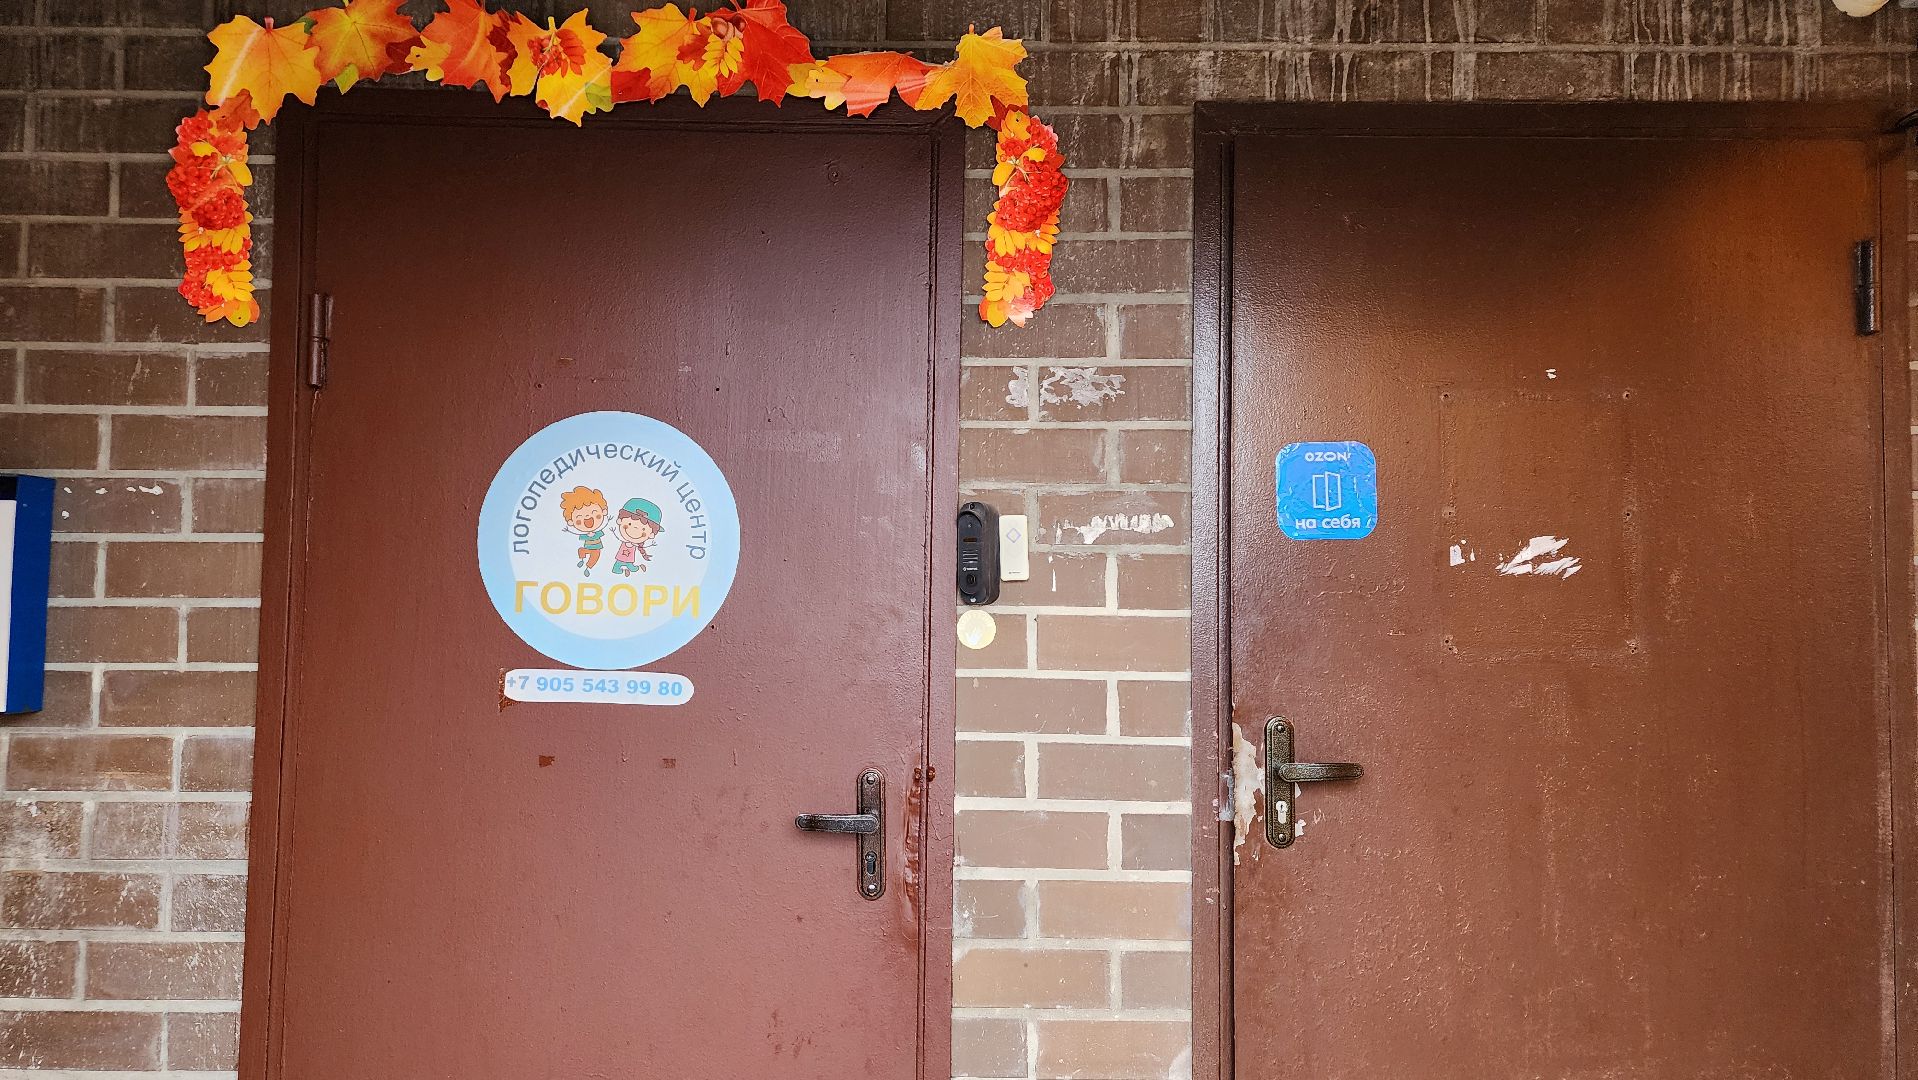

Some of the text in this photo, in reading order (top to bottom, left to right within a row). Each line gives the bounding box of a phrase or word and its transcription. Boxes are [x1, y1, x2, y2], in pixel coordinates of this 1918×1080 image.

[1304, 451, 1349, 462] OZON
[513, 443, 707, 560] логопедический центр
[1295, 513, 1361, 530] на себя
[514, 580, 701, 619] ГОВОРИ
[506, 675, 683, 697] +7 905 543 99 80
